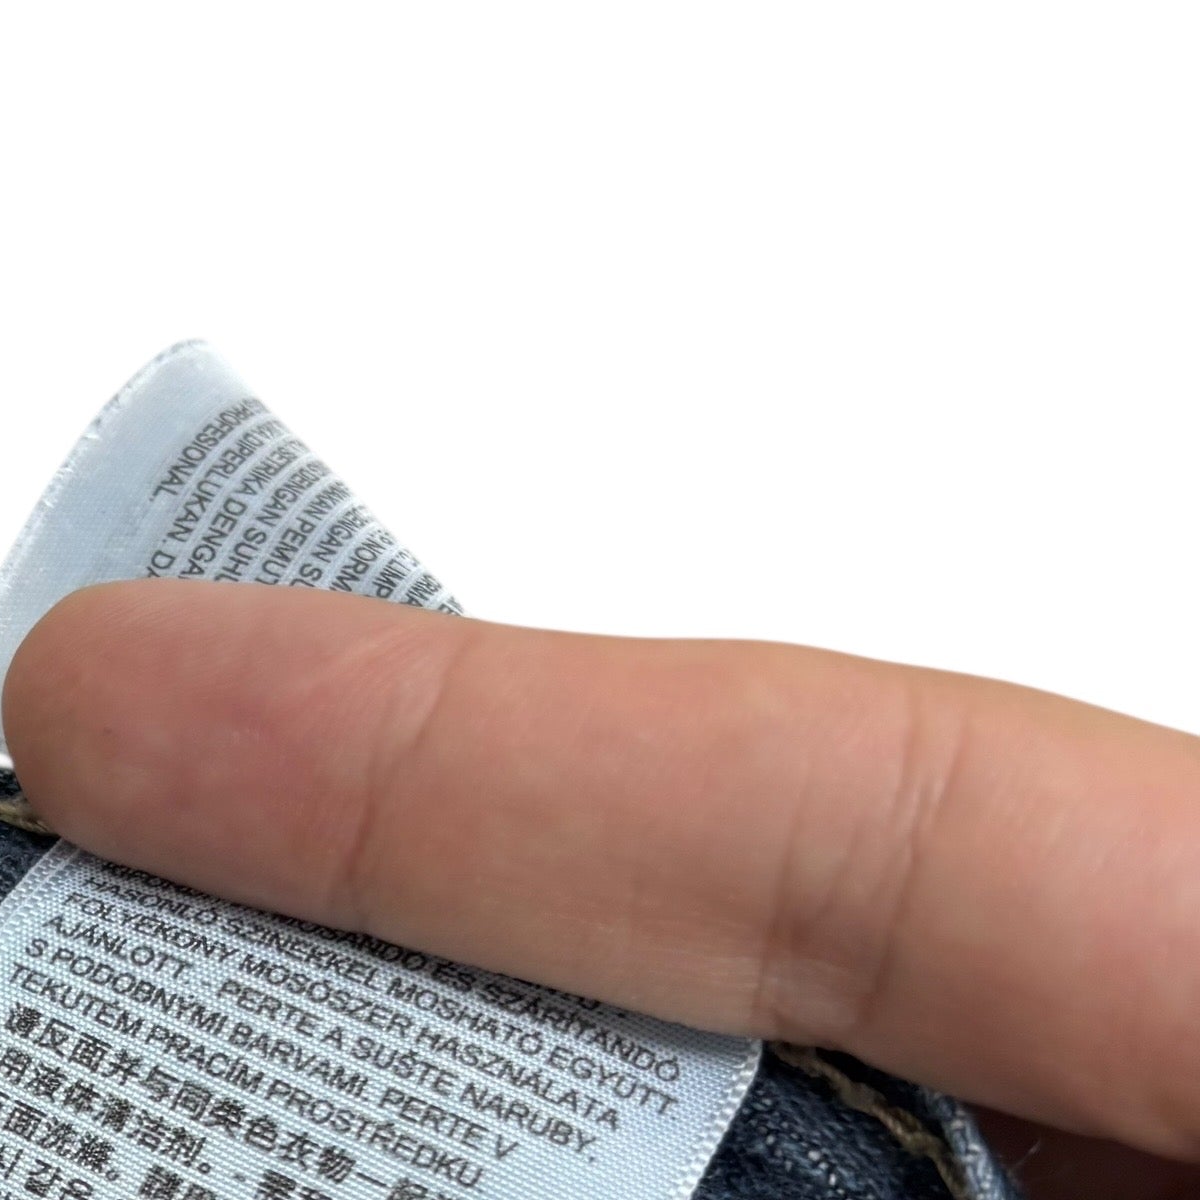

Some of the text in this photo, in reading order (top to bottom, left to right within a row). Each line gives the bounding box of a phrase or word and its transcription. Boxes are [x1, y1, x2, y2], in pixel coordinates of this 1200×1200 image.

[150, 401, 256, 502] PROFESIONAL.
[162, 431, 265, 543] DIPERLUKAN.
[234, 446, 298, 497] SETRIKA
[255, 466, 321, 528] DENGAN
[178, 498, 248, 579] DENGA
[254, 516, 316, 586] PEMUT
[329, 537, 387, 592] NORM
[373, 556, 407, 599] LIMP
[83, 877, 219, 926] HASONLÓ
[387, 976, 544, 1056] MOSHATÓ
[9, 961, 147, 1039] TEKUTÉM
[145, 1023, 266, 1095] PRACÍM
[25, 938, 520, 1162] S PODOBNÝMI BARVAMI. PERTE V
[218, 978, 323, 1038] PERTE
[321, 1025, 345, 1048] A
[351, 1034, 461, 1094] SUŠTE
[239, 954, 414, 1037] MOSÓSZER
[415, 1026, 619, 1131] HASZNÁLATA
